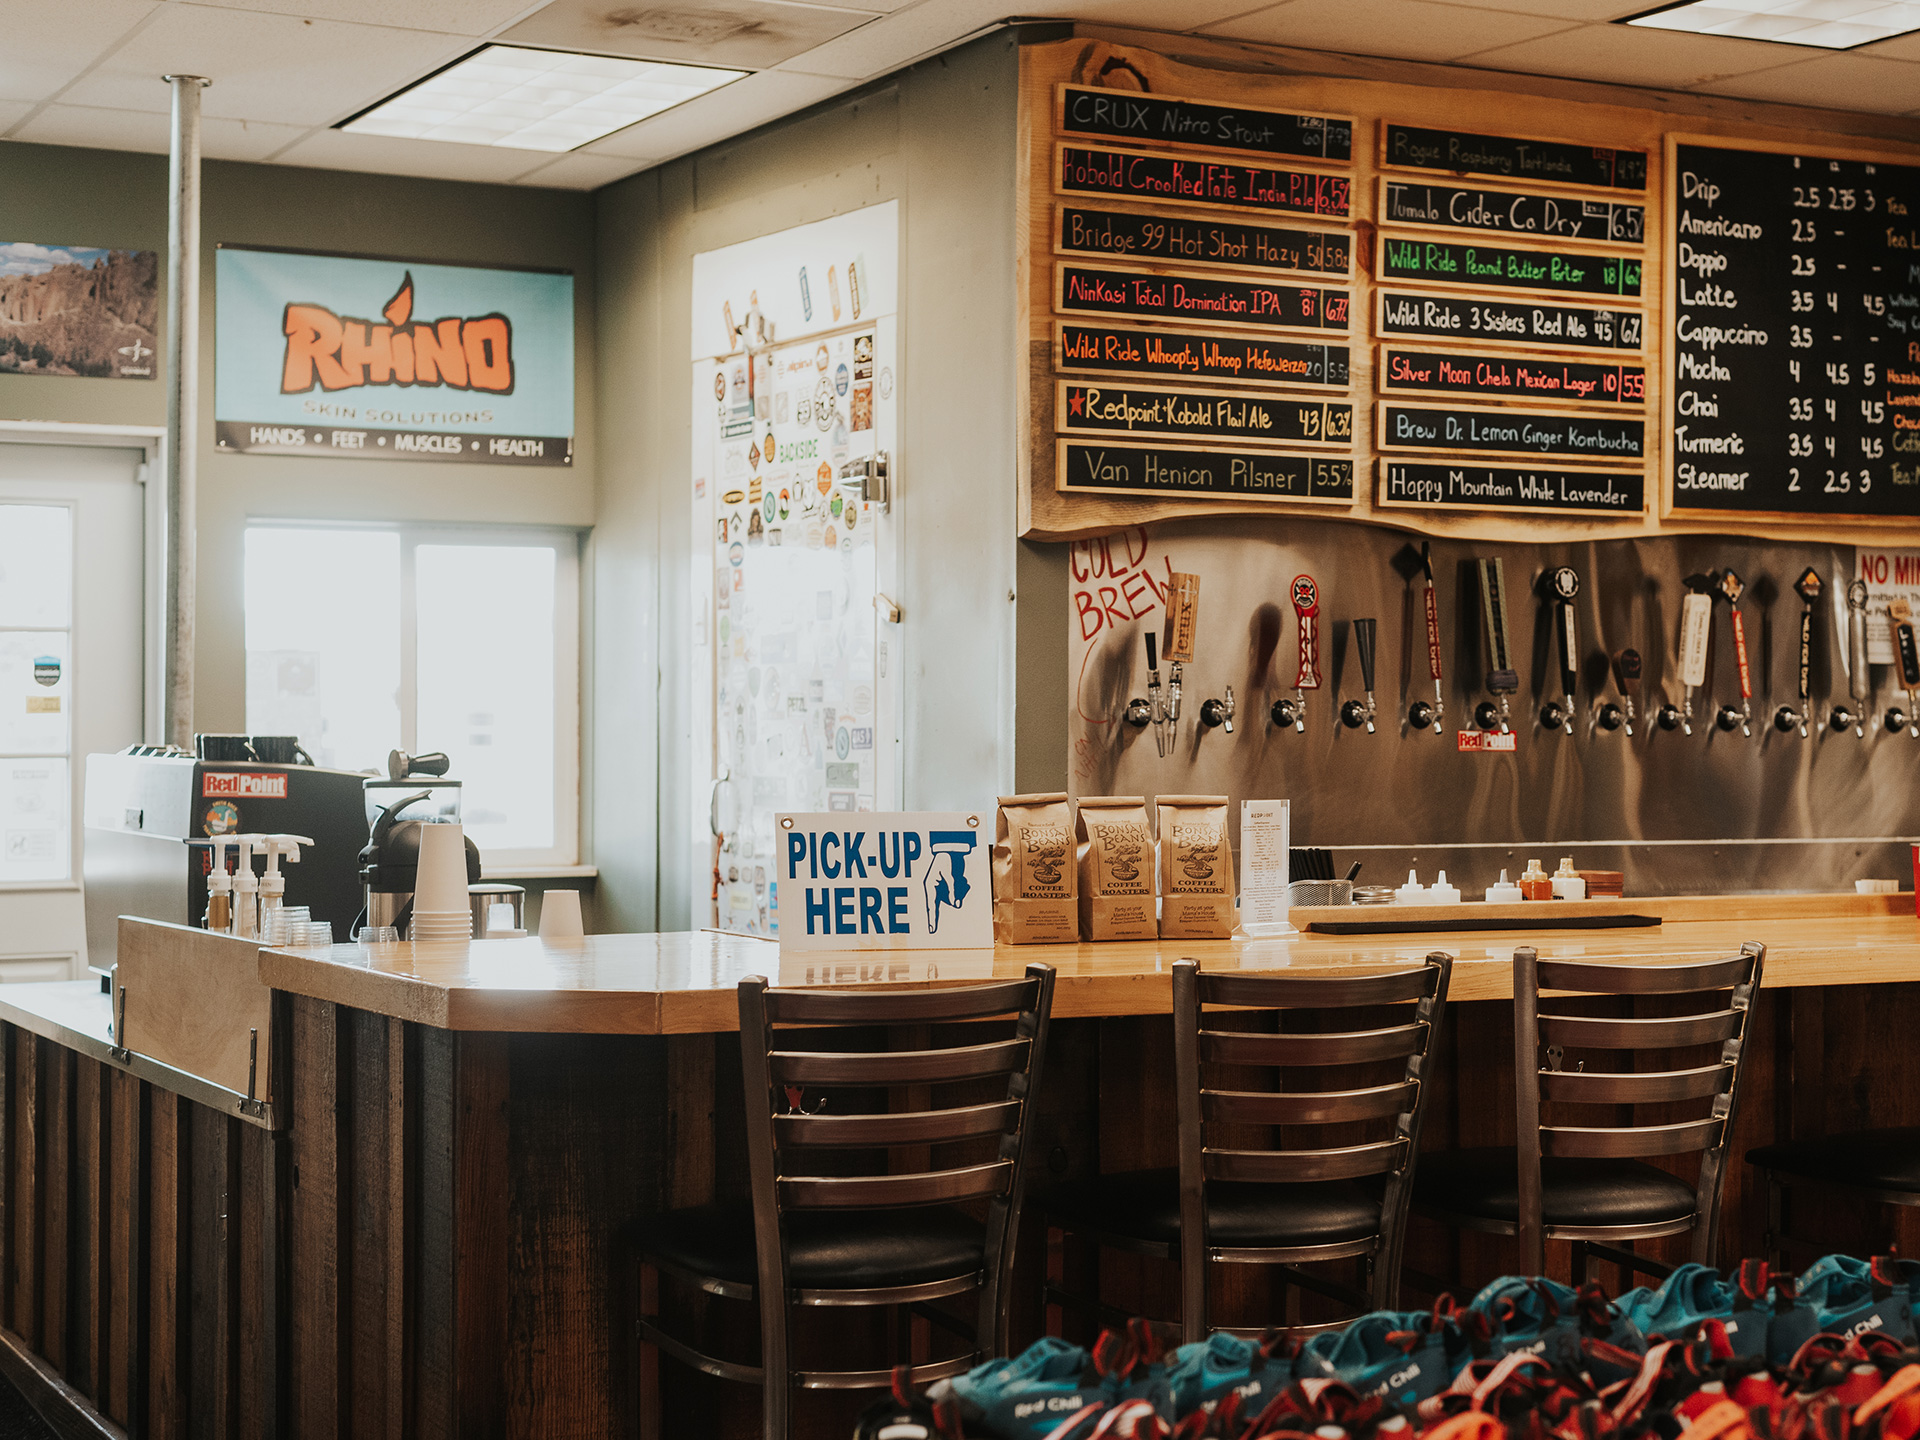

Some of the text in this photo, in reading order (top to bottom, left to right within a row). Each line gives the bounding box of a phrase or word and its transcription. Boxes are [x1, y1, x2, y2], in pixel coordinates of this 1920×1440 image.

[1072, 96, 1150, 131] CRUX
[1162, 108, 1210, 135] Nitro
[1217, 116, 1274, 144] Stout
[1682, 171, 1720, 208] Drip
[1864, 190, 1876, 212] 3
[1387, 184, 1440, 221] Tumalo
[1449, 191, 1504, 226] Cider
[1544, 199, 1582, 238] Dry
[1679, 209, 1762, 240] Americano
[1071, 214, 1135, 254] Bridge
[1142, 224, 1165, 250] 99
[1170, 226, 1203, 256] Hot
[1209, 230, 1248, 258] Shot
[1256, 234, 1299, 270] Hazy
[1388, 242, 1421, 270] Wild
[1425, 244, 1458, 272] Ride
[1603, 267, 1617, 285] 18
[1679, 243, 1728, 278] Doppio
[1131, 280, 1166, 306] Total
[1173, 283, 1248, 313] Domination
[1250, 289, 1282, 316] IPA
[1301, 298, 1314, 316] 81
[1680, 278, 1737, 309] Latte
[1827, 292, 1838, 313] 4
[1385, 300, 1641, 344] Wild Ride 3 Sisters Red Ale 45 6%
[1676, 314, 1814, 351] Cappuccino 3.5
[1063, 333, 1099, 360] Wild
[1105, 336, 1141, 362] Ride
[1202, 342, 1242, 375] Whoop
[1304, 361, 1322, 378] 20
[1678, 352, 1876, 387] Mocha 4 4.5 5
[1390, 356, 1617, 397] Silver Moon Chela Mexican Lager 10
[303, 400, 494, 425] SKIN SOLUTIONS
[1085, 388, 1163, 430] Redpoint
[1166, 395, 1212, 426] Kobold
[1249, 406, 1273, 430] Ale
[1299, 408, 1320, 437] 43
[1677, 390, 1718, 418] Chai
[1789, 397, 1814, 421] 3.5
[1825, 398, 1837, 423] 4
[250, 426, 544, 458] HANDS FEET MUSCLES HEALTH
[1397, 414, 1640, 452] Brew Dr. Lemon Ginger Kombucha
[1674, 425, 1884, 460] Turmeric 3.5 4 4.5
[779, 438, 819, 464] BACKSIDE
[1085, 450, 1129, 482] Van
[1145, 454, 1213, 486] Henion
[1230, 458, 1297, 490] Pilsner
[1449, 470, 1513, 497] Mountain
[1518, 475, 1555, 500] White
[1561, 477, 1628, 504] Lavender
[1677, 463, 1872, 494] Steamer 2 2.5 3
[1071, 526, 1148, 583] COLD
[1861, 554, 1889, 585] NO
[1020, 827, 1069, 840] BONSAI
[1027, 836, 1070, 853] BEANS
[1095, 824, 1143, 839] BONSAI
[1102, 833, 1145, 851] BEANS
[1172, 824, 1222, 837] BONSAI
[1178, 833, 1224, 849] BEANS
[788, 831, 922, 879] PICK-UP
[805, 887, 911, 935] HERE
